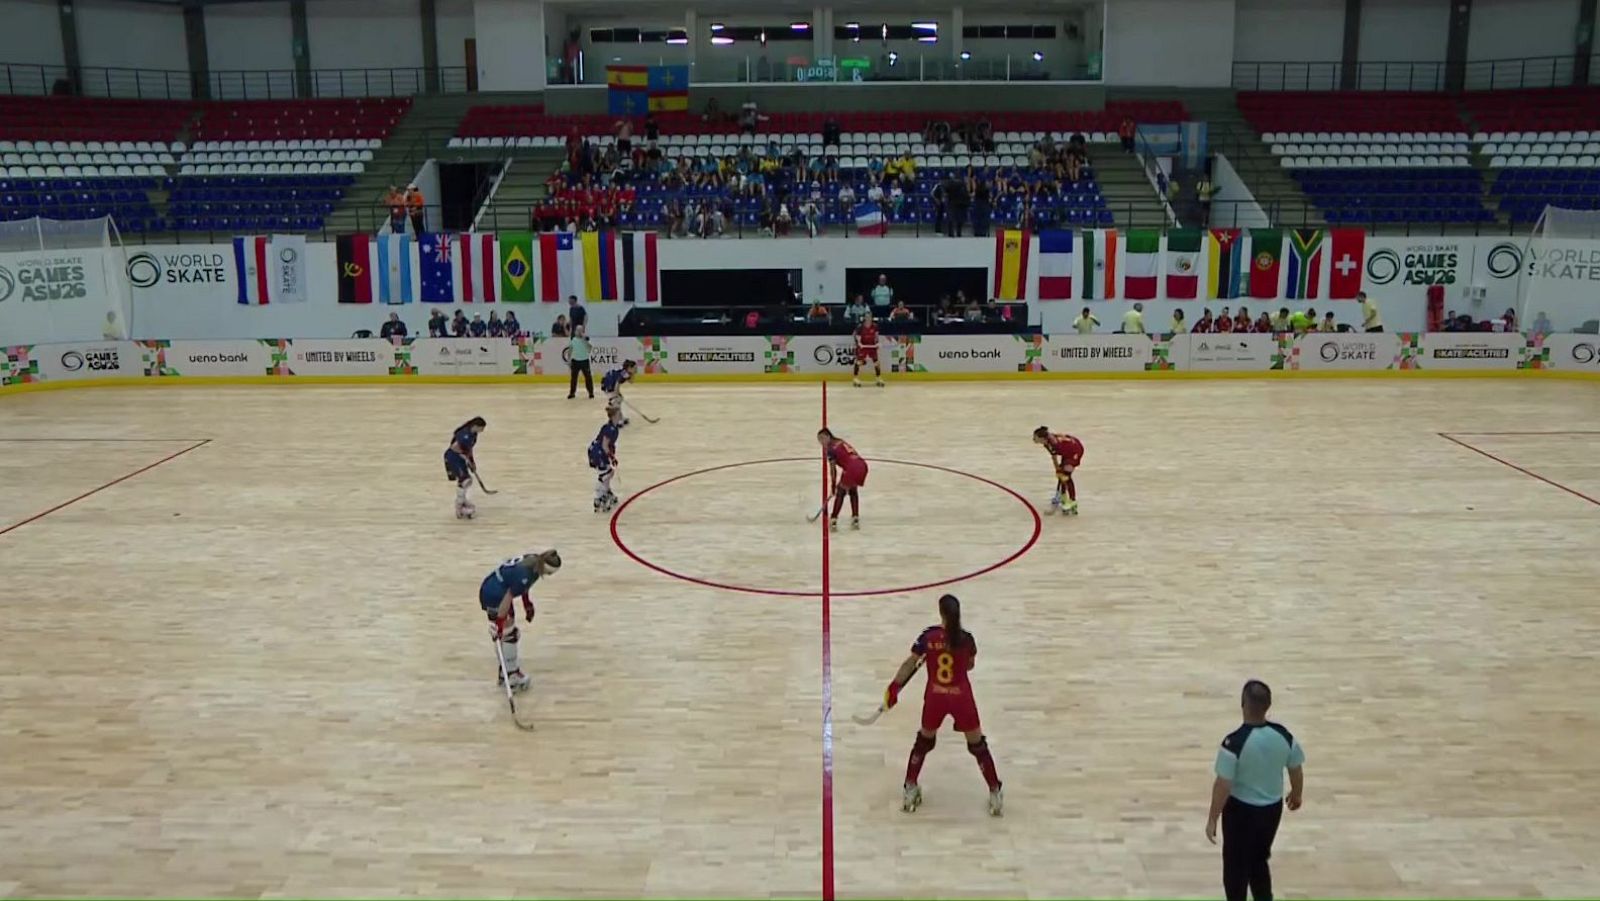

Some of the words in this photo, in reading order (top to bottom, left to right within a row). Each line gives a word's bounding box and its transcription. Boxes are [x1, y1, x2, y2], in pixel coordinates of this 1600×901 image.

[164, 254, 223, 267] WORLD
[1404, 253, 1458, 268] GAMES
[18, 265, 85, 285] GAMES
[166, 268, 226, 283] SKATE
[85, 352, 119, 361] GAMES
[188, 354, 218, 363] ueno
[219, 352, 249, 363] bank
[305, 351, 333, 362] UNITED
[334, 351, 345, 362] BY
[346, 351, 376, 362] WHEELS
[938, 350, 969, 359] ueno
[971, 348, 1001, 359] bank
[1060, 347, 1089, 358] UNITED
[1090, 347, 1101, 358] BY
[1102, 347, 1133, 358] WHEELS
[1341, 351, 1376, 360] SKATE
[590, 355, 618, 364] KATE
[936, 653, 954, 683] 8
